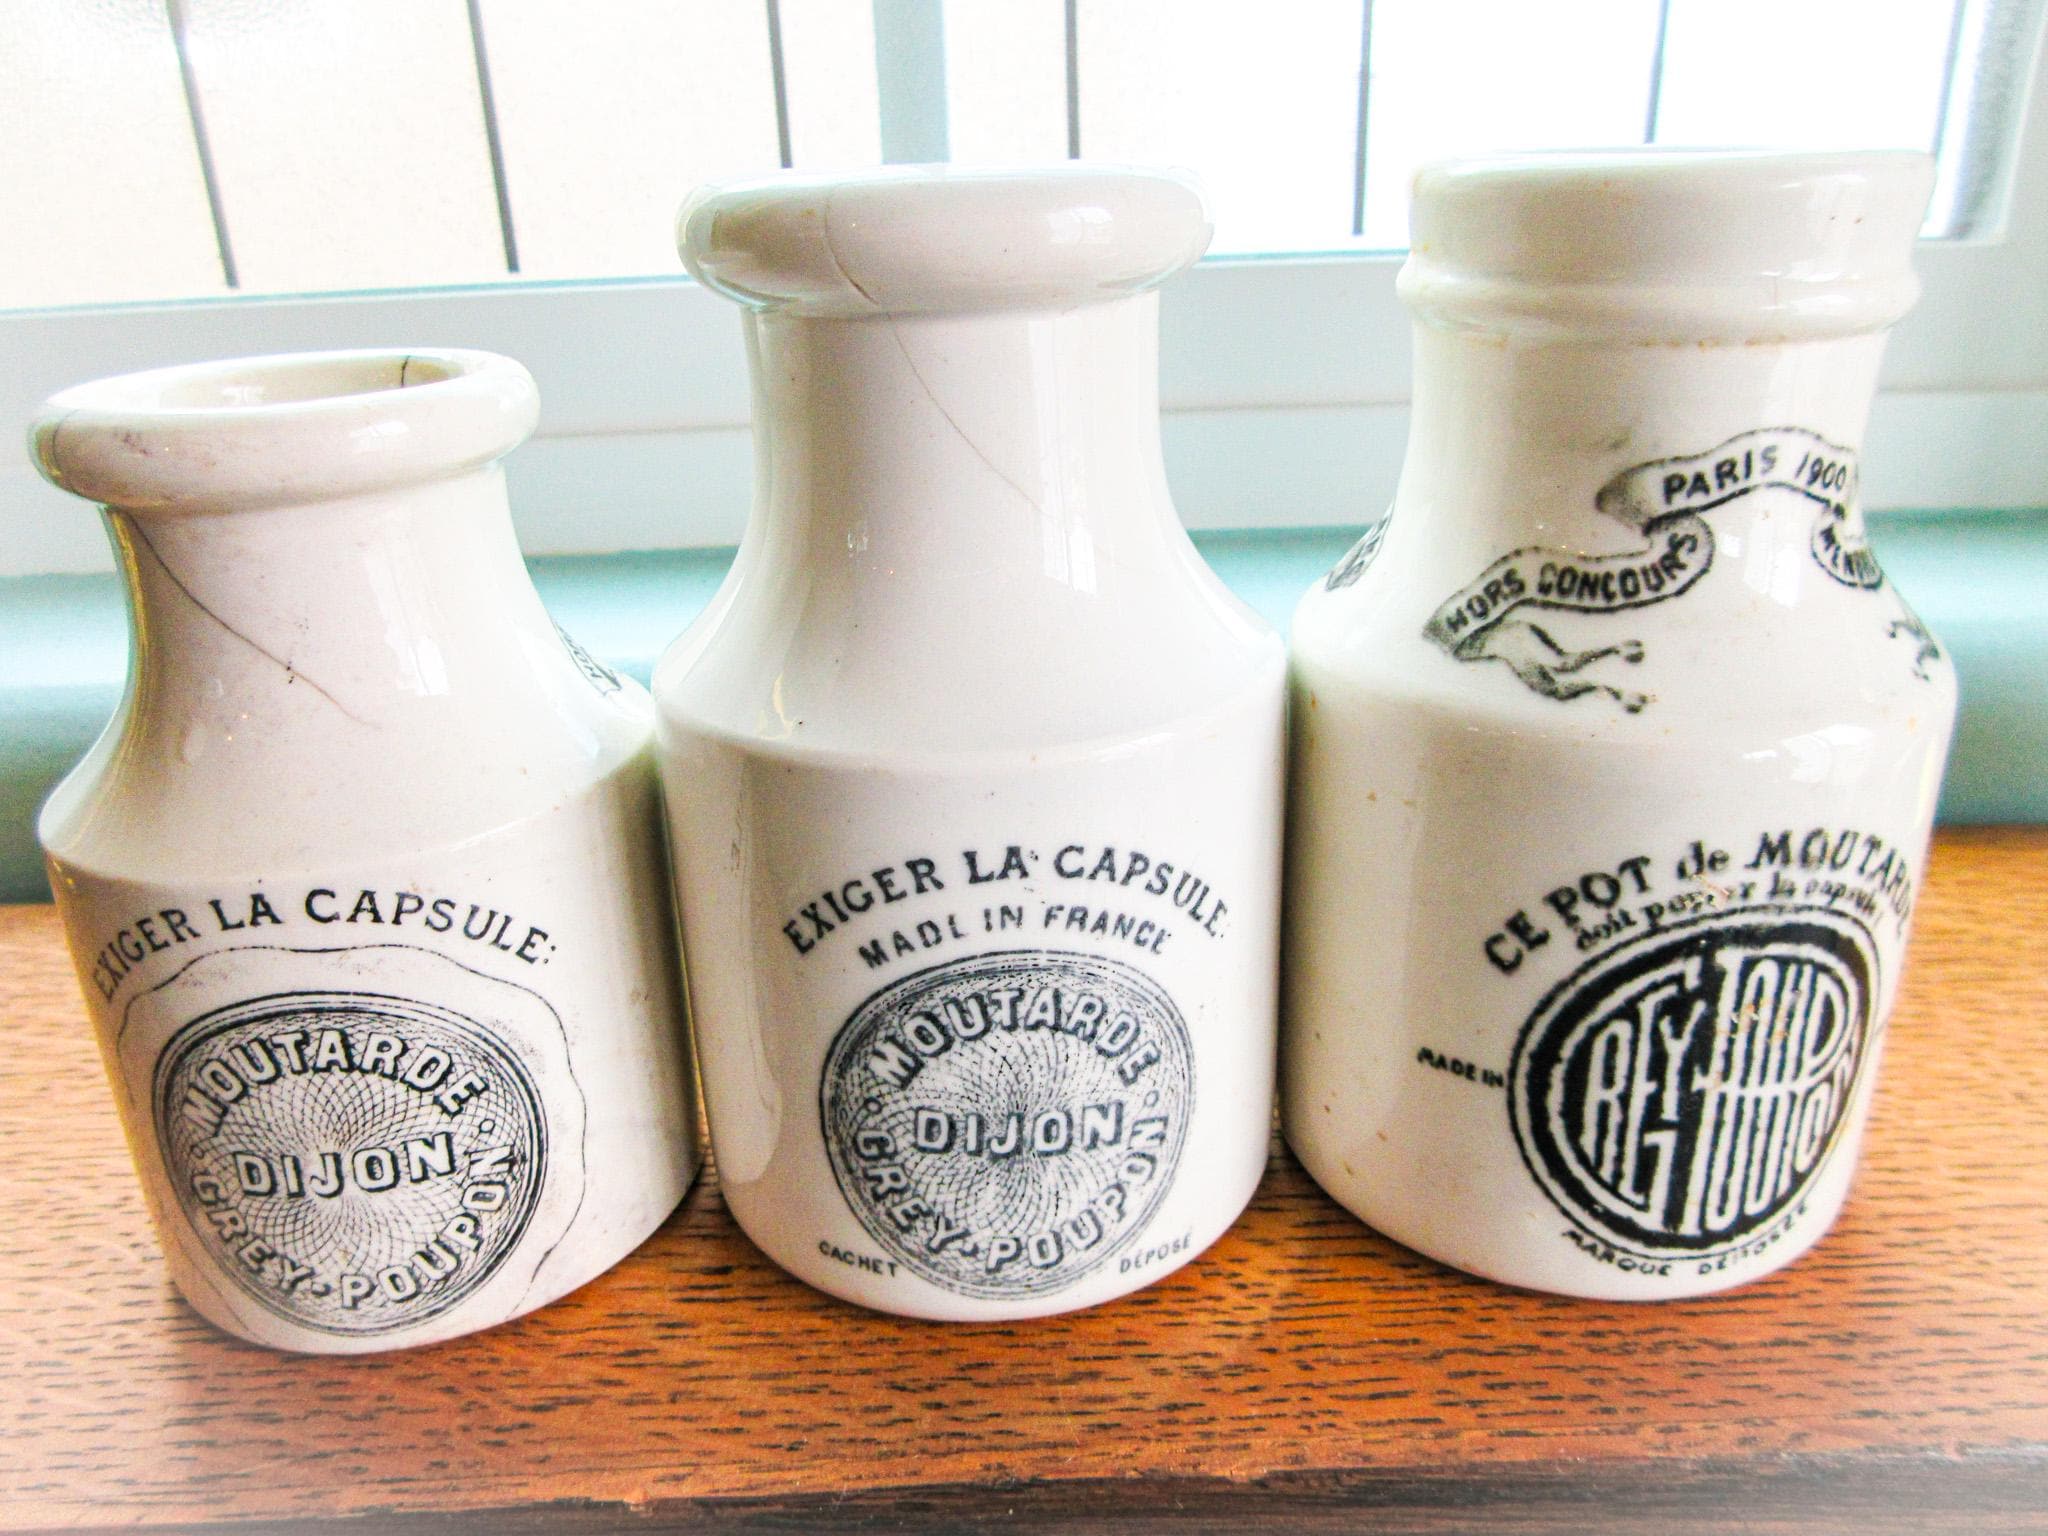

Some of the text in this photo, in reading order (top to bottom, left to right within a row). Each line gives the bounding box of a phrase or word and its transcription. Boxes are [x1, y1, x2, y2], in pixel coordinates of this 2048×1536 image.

[1663, 445, 1848, 504] PARIS 1900
[1446, 532, 1698, 633] HORS CONCOURS
[783, 857, 945, 955] EXIGER
[962, 845, 1030, 885] LA
[983, 904, 1024, 933] IN
[1484, 909, 1550, 976] CE
[1542, 855, 1652, 928] POT
[1677, 839, 1730, 881] de
[93, 908, 201, 1003] EXIGER
[208, 892, 284, 931] LA
[866, 986, 1161, 1091] MOUTARDE
[1416, 1046, 1505, 1088] MADE IN
[183, 1027, 490, 1137] MOUTARDE
[915, 1100, 1125, 1161] DIJON
[233, 1131, 457, 1199] DIJON
[818, 1240, 898, 1278] CACHET
[1561, 1228, 1673, 1277] MARQUE
